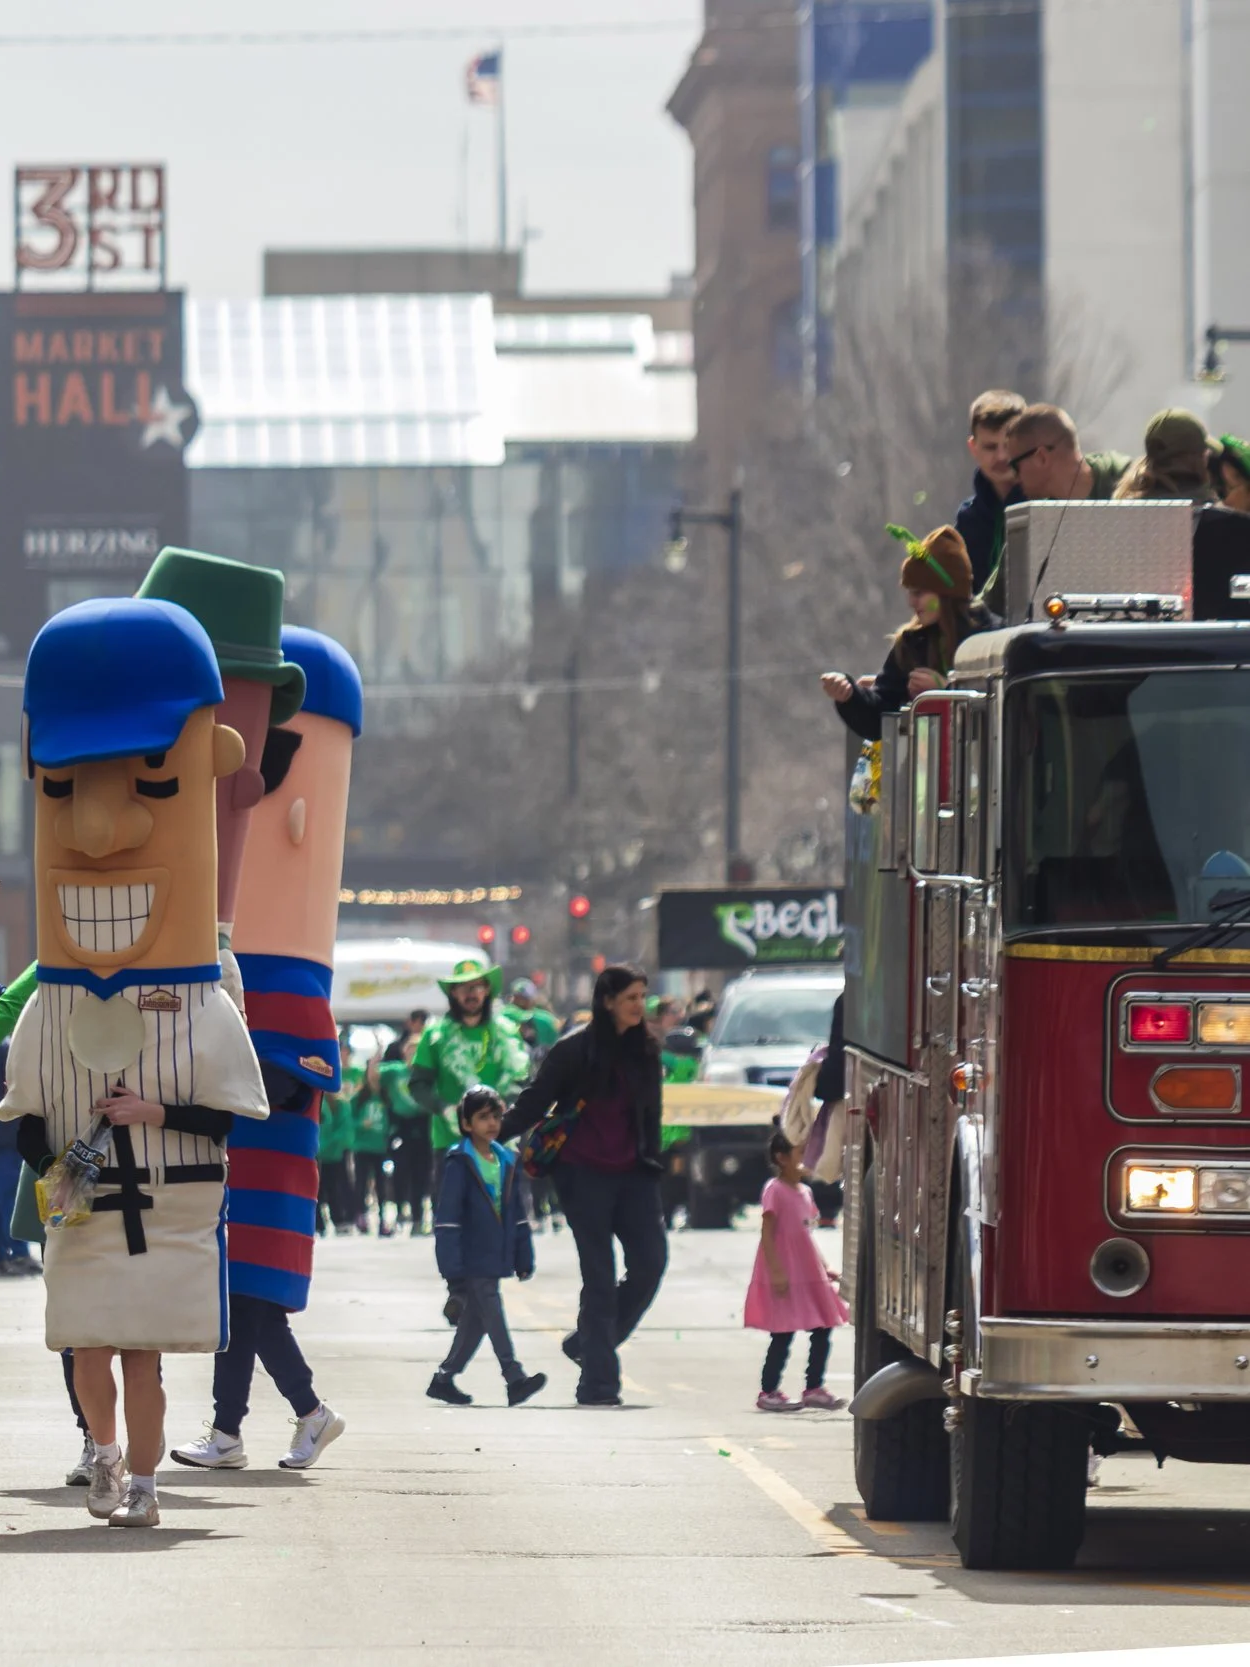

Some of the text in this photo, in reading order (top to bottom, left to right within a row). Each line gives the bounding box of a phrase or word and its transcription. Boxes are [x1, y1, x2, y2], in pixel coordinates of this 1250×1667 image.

[89, 224, 163, 270] ST
[14, 328, 165, 364] MARKET
[14, 370, 166, 426] HALL
